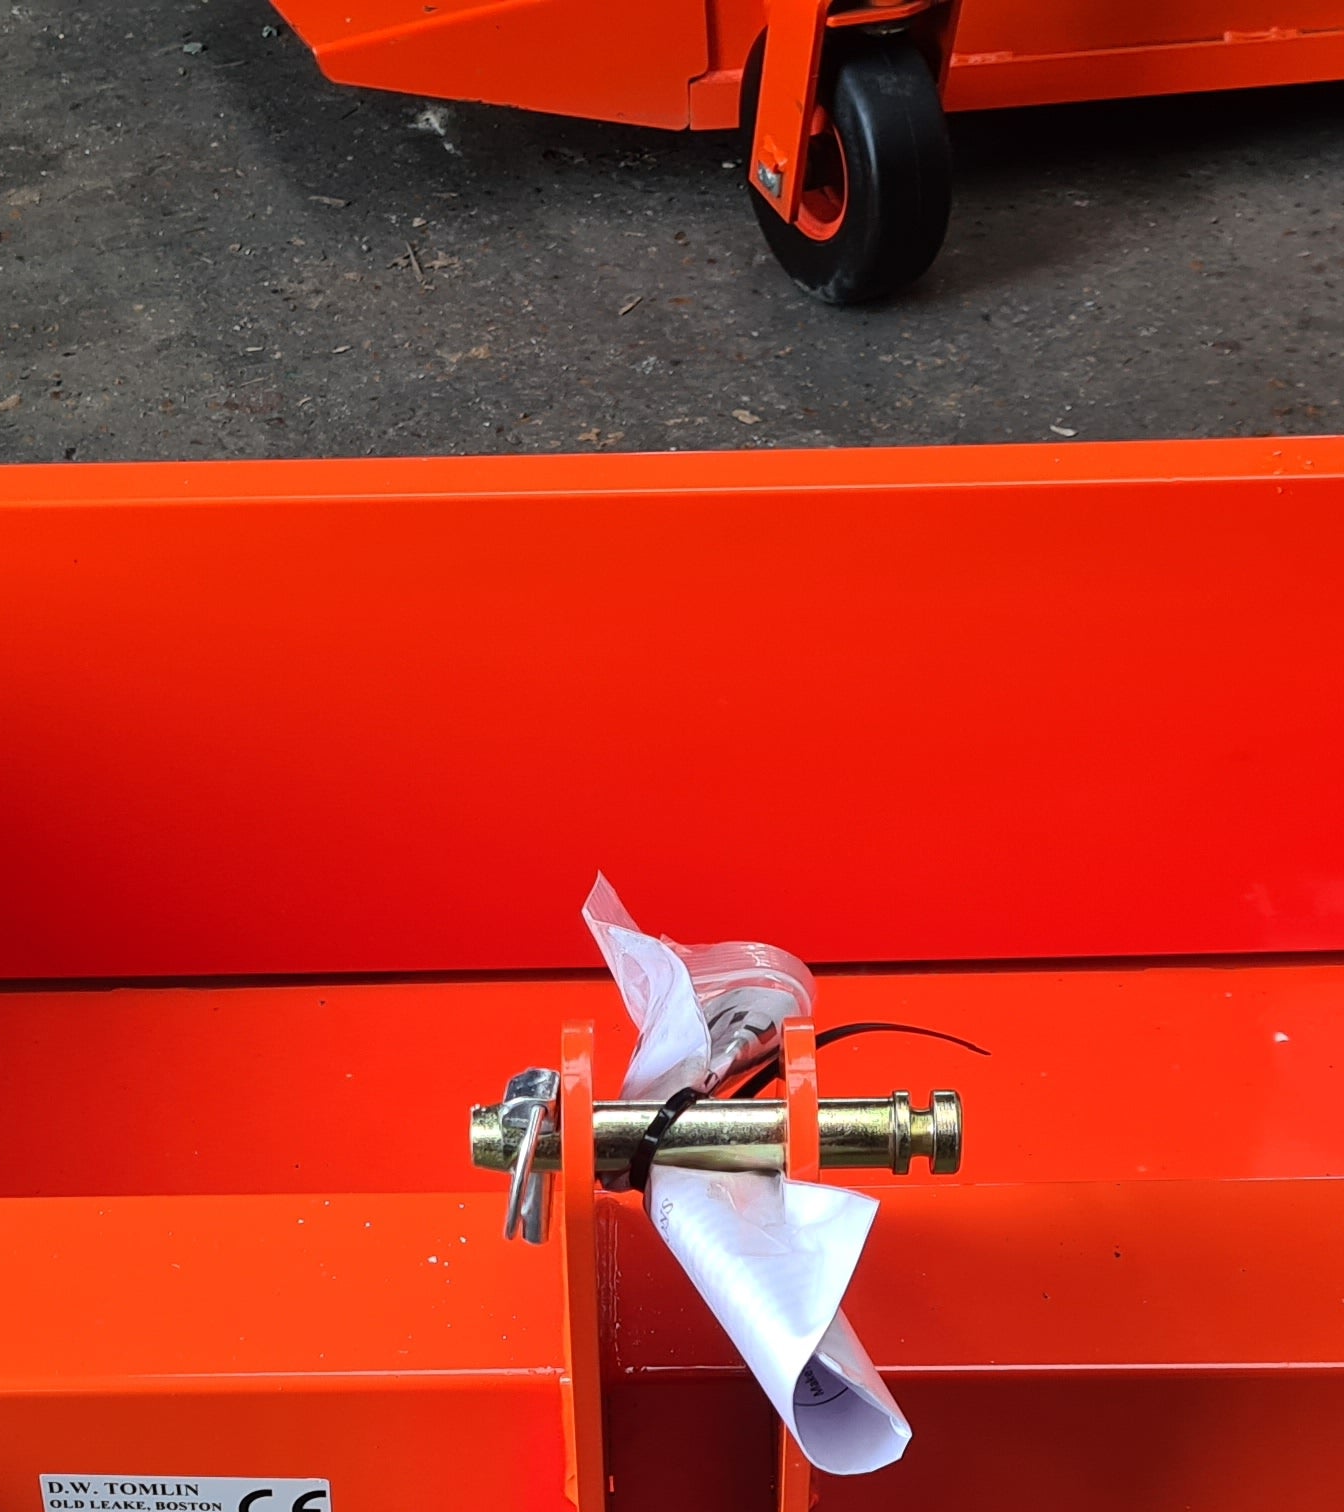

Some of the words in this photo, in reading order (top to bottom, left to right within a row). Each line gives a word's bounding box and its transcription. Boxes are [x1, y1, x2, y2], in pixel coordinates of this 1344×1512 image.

[48, 1481, 99, 1495] D.W.
[103, 1482, 199, 1497] TOMLIN
[49, 1499, 85, 1510] OLD
[89, 1500, 152, 1512] LEAKE,
[155, 1501, 223, 1512] BOSTON
